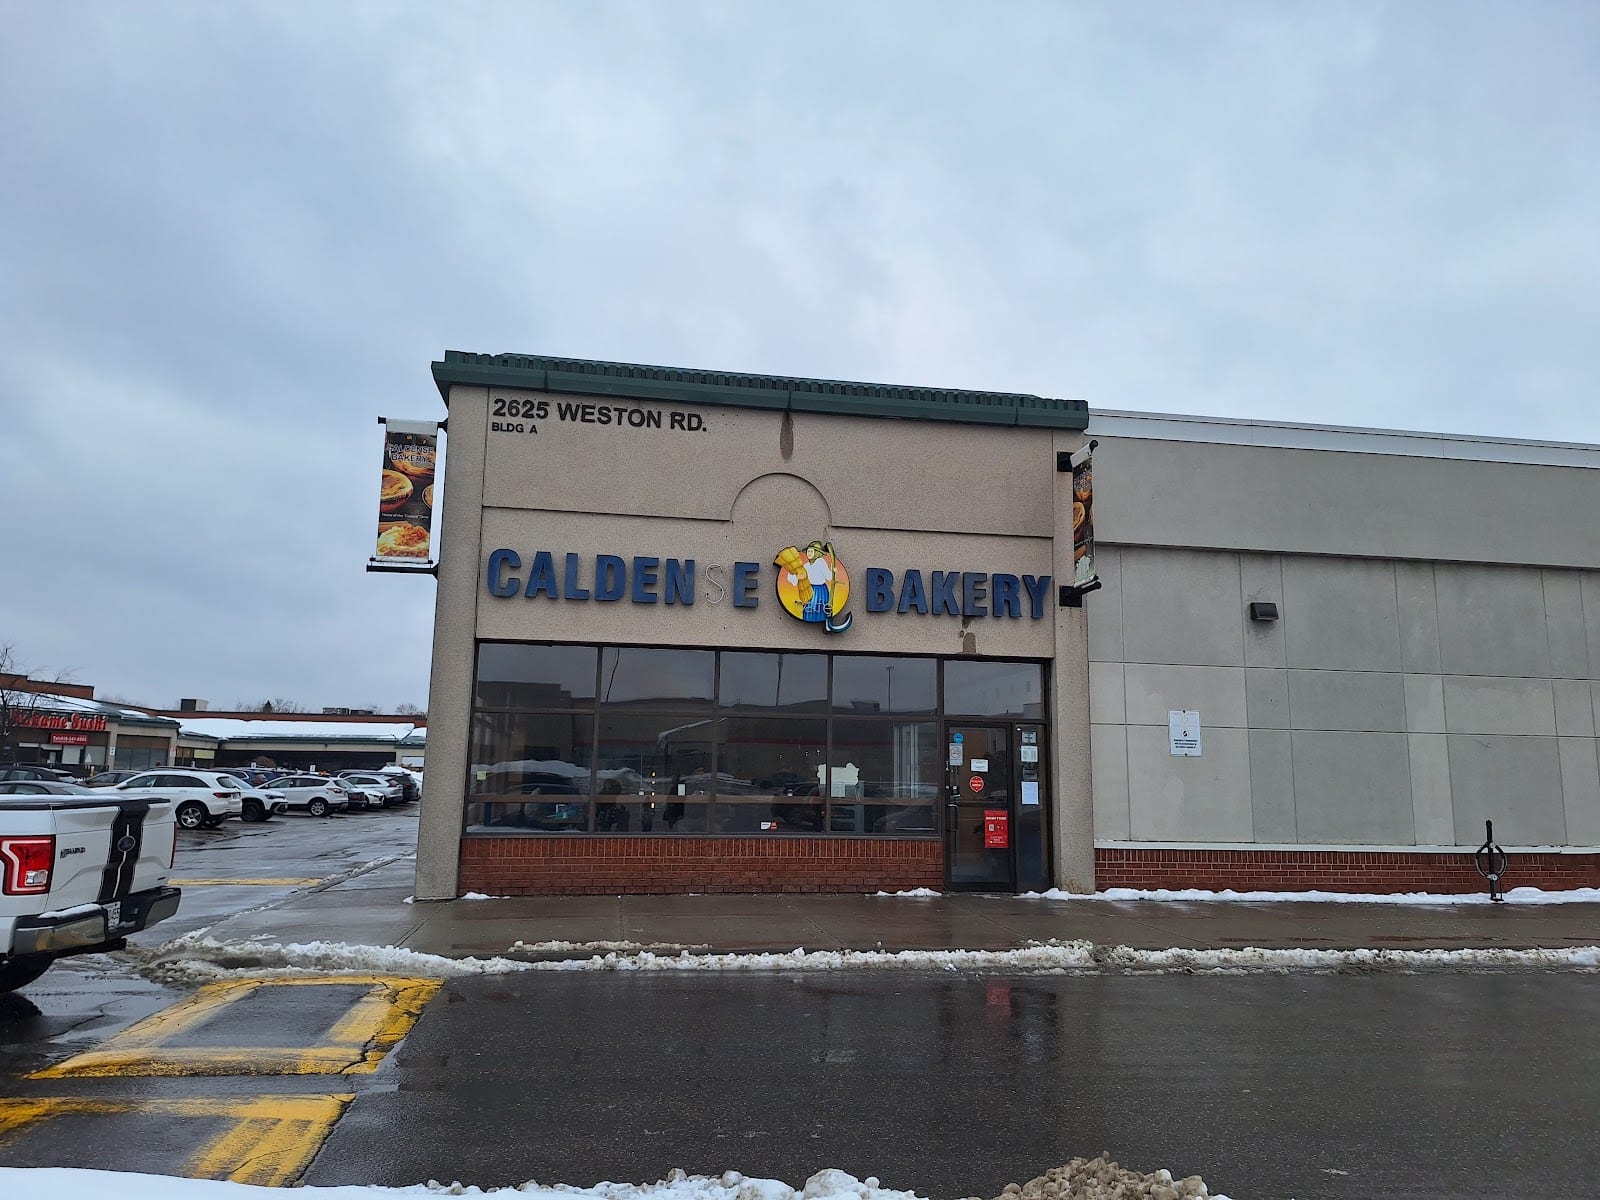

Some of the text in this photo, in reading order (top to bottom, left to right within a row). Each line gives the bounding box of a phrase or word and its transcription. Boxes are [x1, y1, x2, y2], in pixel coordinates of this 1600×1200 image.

[491, 422, 538, 434] BLDG A
[492, 398, 707, 432] 2625 WESTON RD.
[391, 453, 428, 463] BAKERY
[487, 548, 760, 609] CALDENSE
[866, 567, 1052, 619] BAKERY
[71, 712, 109, 731] Sushi
